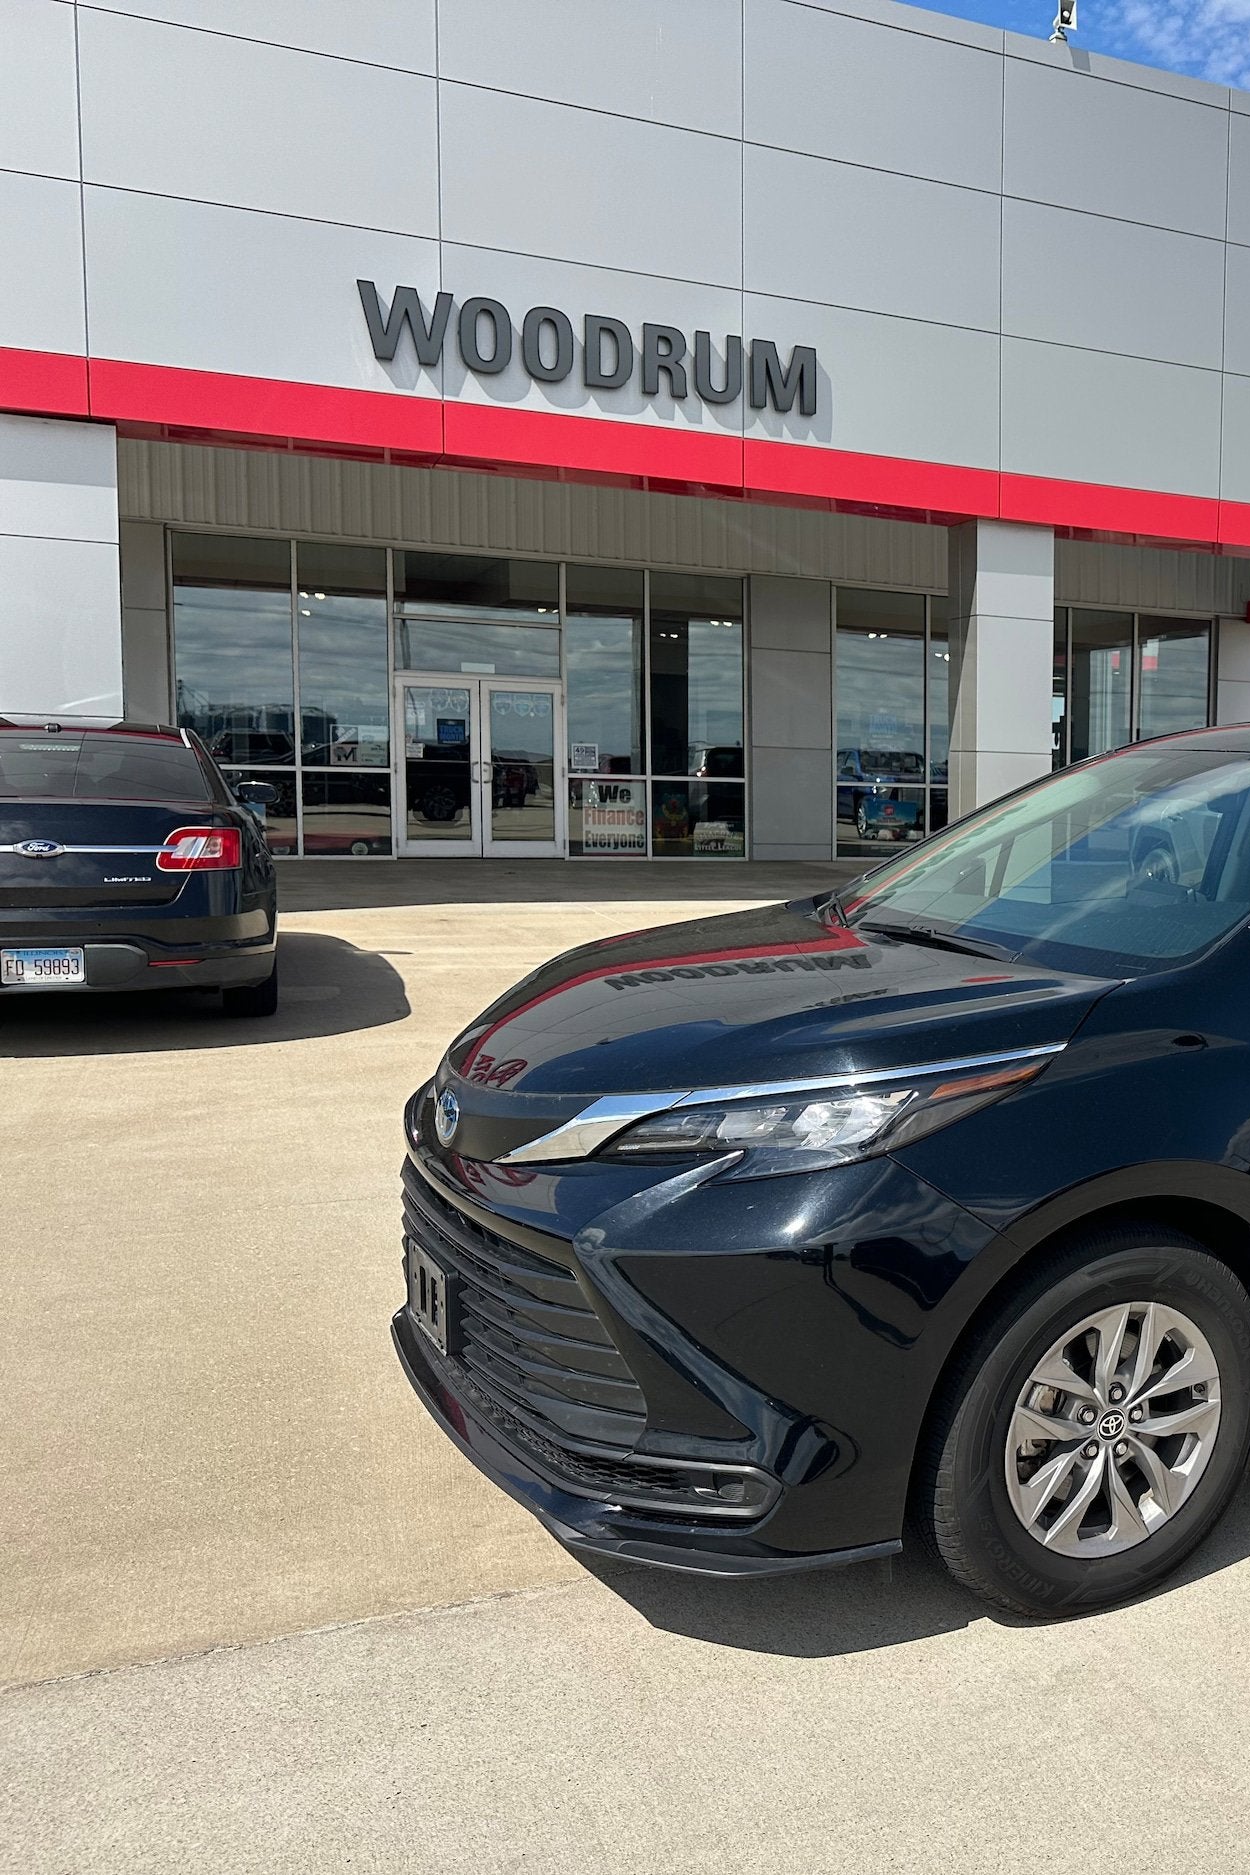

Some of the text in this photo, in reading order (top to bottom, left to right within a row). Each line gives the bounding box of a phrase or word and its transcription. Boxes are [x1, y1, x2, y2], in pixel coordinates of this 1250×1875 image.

[356, 279, 817, 416] WOODRUM
[597, 784, 632, 804] We
[584, 806, 645, 826] Finance
[27, 842, 51, 852] Ford
[584, 830, 645, 850] Everyone
[34, 958, 80, 976] 59893
